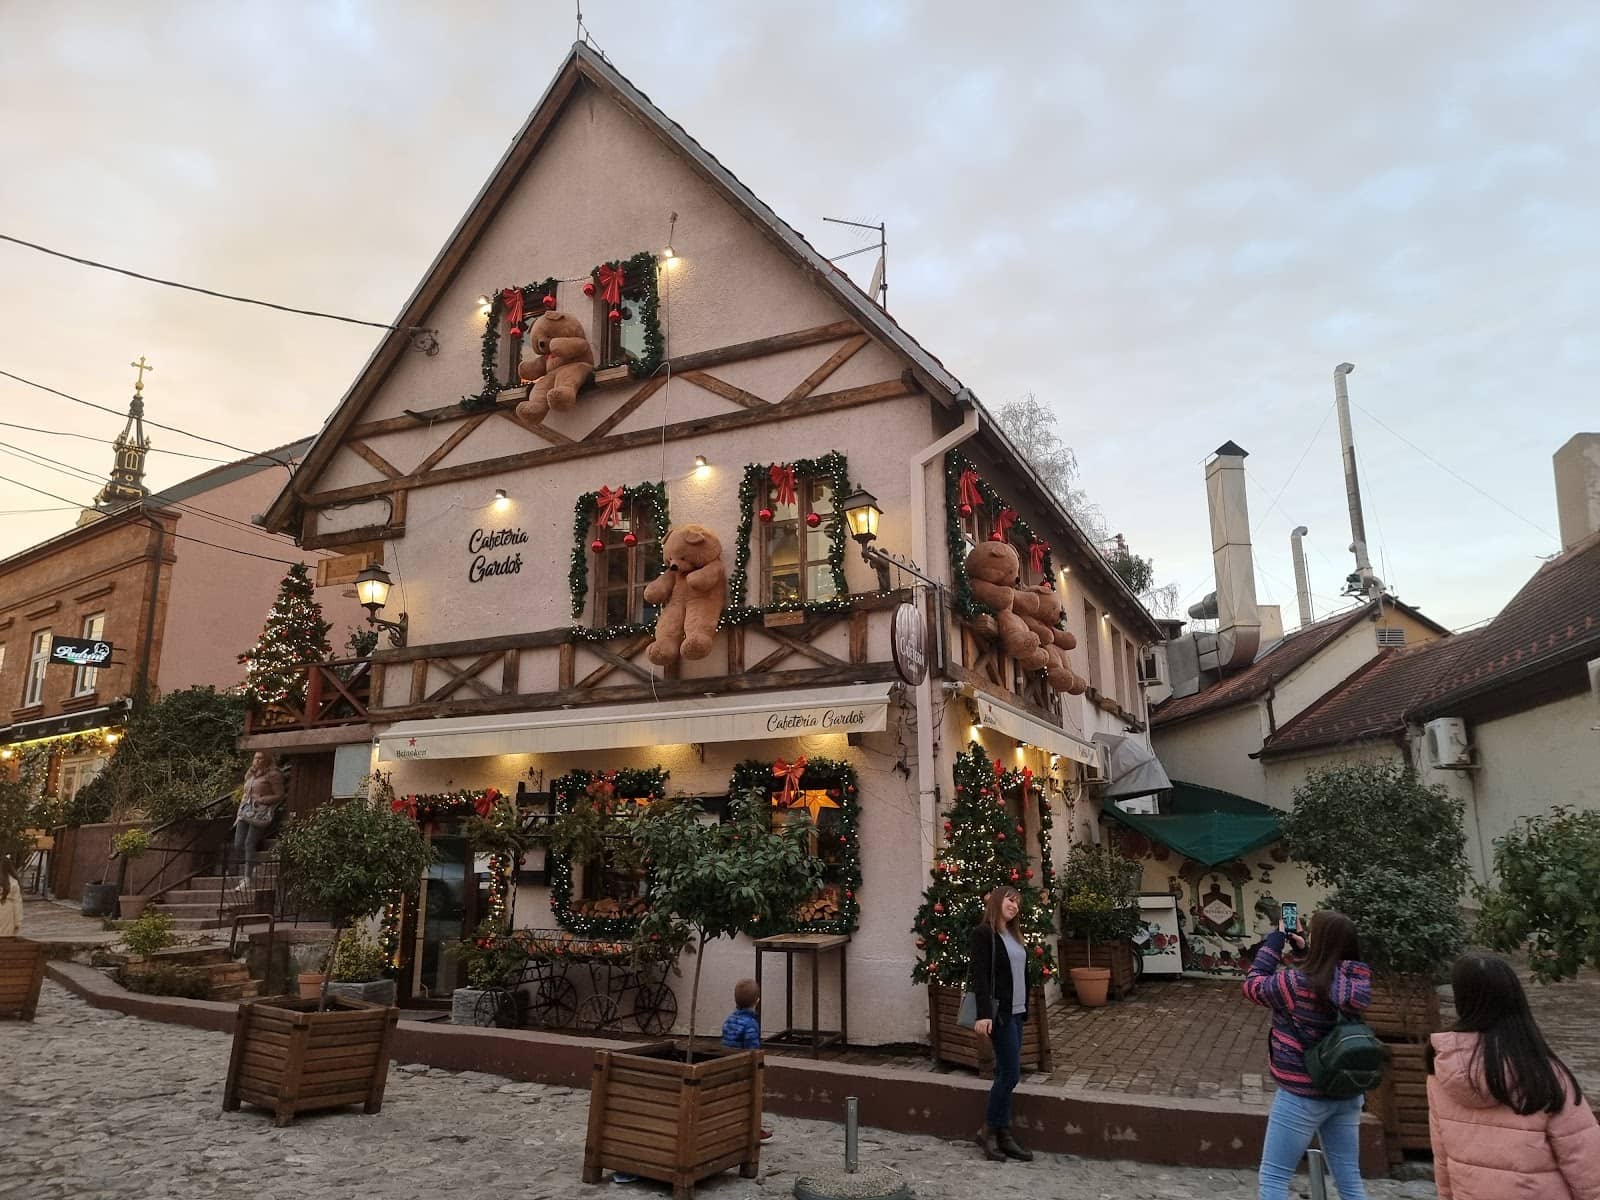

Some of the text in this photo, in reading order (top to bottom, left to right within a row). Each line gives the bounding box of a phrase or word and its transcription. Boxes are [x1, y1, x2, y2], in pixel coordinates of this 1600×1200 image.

[469, 527, 529, 554] Cafeteria
[469, 552, 523, 583] Gardoš
[766, 713, 818, 733] Cafeteria
